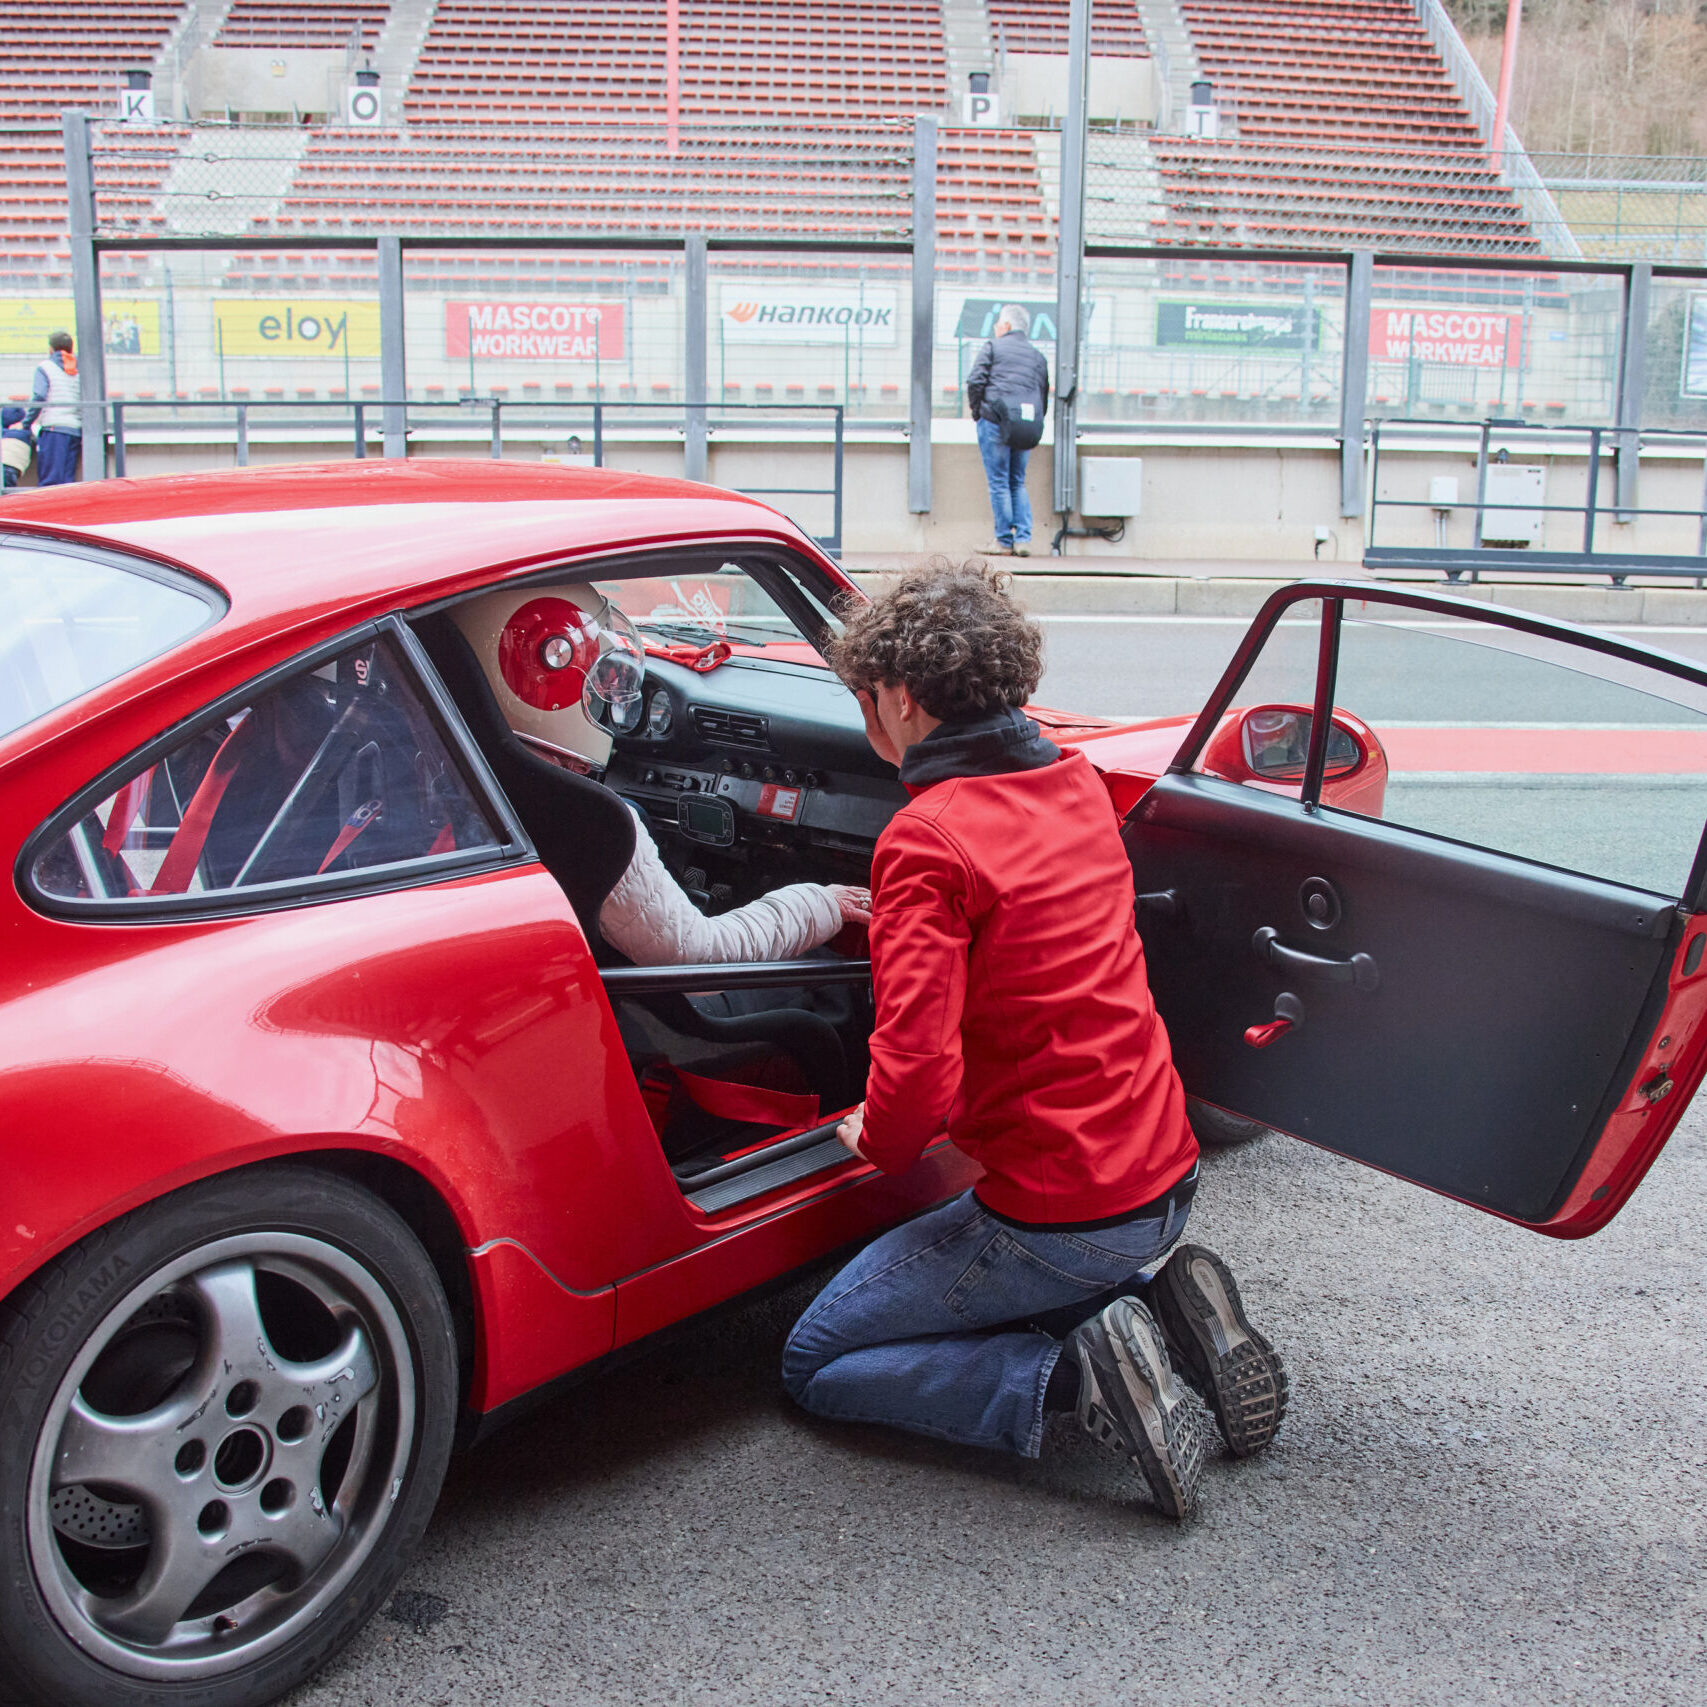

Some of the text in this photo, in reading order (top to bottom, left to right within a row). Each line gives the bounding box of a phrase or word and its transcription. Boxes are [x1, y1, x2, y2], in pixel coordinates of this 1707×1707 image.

[126, 94, 146, 117] K
[352, 91, 379, 120] O
[971, 97, 991, 122] P
[1194, 110, 1208, 136] T
[258, 307, 347, 350] eloy
[471, 335, 599, 356] WORKWEAR
[15, 1254, 132, 1391] YOKOHAMA
